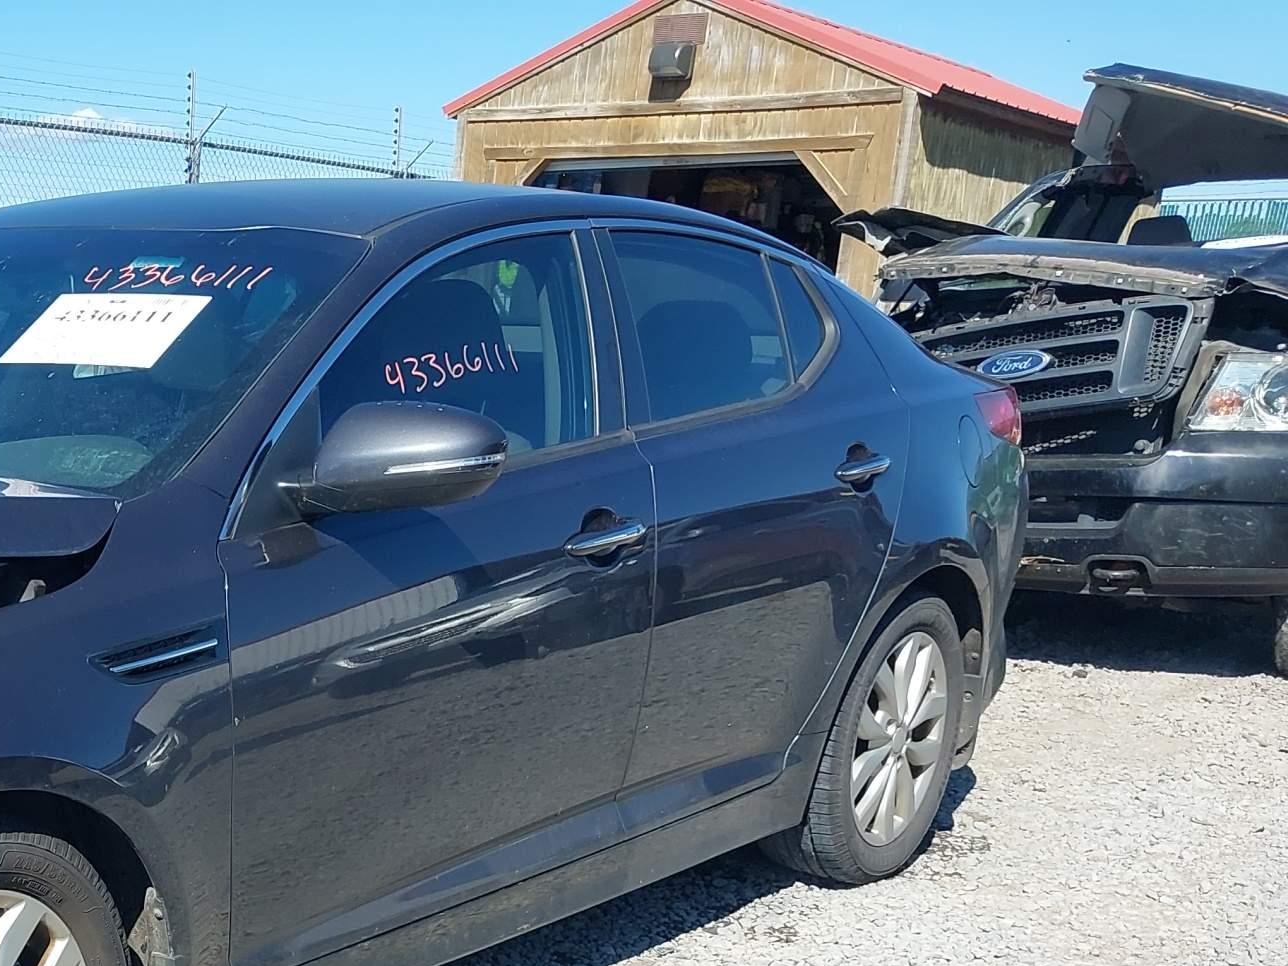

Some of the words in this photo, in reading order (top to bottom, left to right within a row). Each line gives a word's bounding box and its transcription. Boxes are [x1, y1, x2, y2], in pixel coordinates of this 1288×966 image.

[83, 264, 273, 291] 43366111
[385, 341, 519, 394] 43366111
[991, 355, 1033, 374] Ford
